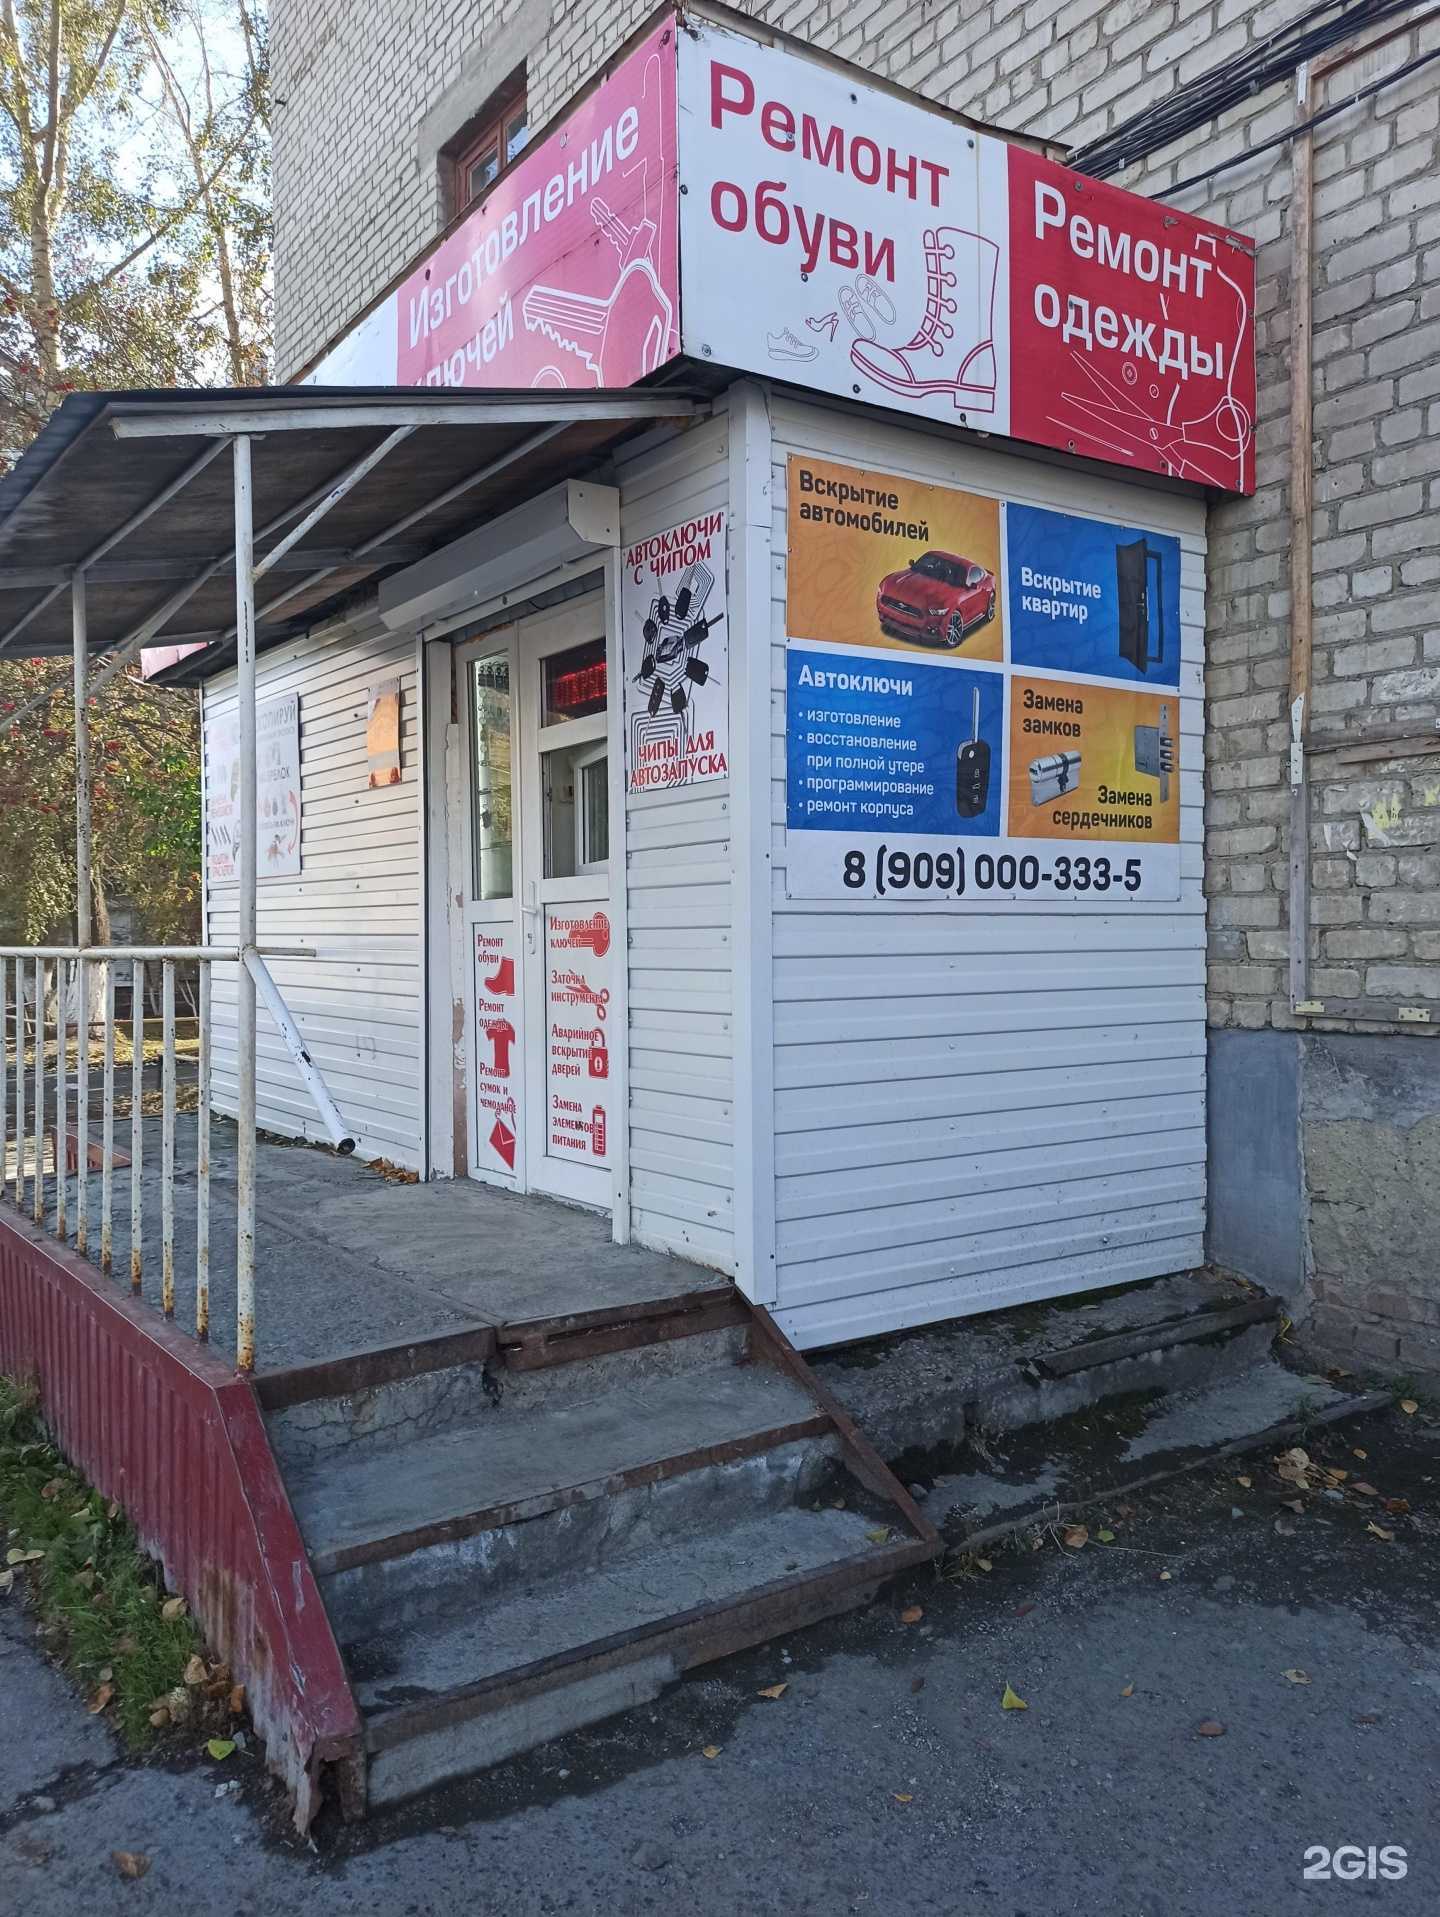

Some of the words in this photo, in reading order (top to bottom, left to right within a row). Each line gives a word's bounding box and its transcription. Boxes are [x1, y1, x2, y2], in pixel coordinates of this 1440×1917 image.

[709, 59, 950, 207] Ремонт
[409, 105, 639, 349] Изготовление
[710, 180, 896, 283] обуви
[1034, 179, 1213, 299] Ремонт
[1033, 283, 1224, 380] одежды
[799, 469, 899, 510] Вскрытие
[799, 502, 929, 542] автомобилей
[626, 513, 723, 569] АВТОКЛЮЧИ
[633, 565, 644, 585] С
[650, 538, 711, 579] ЧИПОМ
[1021, 566, 1102, 600] Вскрытие
[1021, 596, 1089, 624] квартир
[798, 664, 913, 697] Автоключи
[1023, 688, 1083, 714] Замена
[807, 710, 901, 729] изготовление
[1023, 718, 1081, 738] замков
[638, 738, 679, 763] ЧИПЫ
[685, 730, 715, 755] ДЛЯ
[807, 732, 917, 751] восстановление
[630, 752, 728, 788] АВТОЗАПУСКА
[807, 755, 832, 771] при
[835, 756, 885, 771] полной
[888, 762, 925, 777] утере
[807, 777, 934, 796] программирование
[1098, 784, 1153, 807] Замена
[807, 800, 858, 815] ремонт
[860, 803, 914, 819] корпуса
[1052, 810, 1153, 831] сердечников
[843, 849, 866, 890] 8
[876, 844, 966, 896] (909)
[974, 854, 1142, 892] 000-333-5
[477, 934, 504, 948] Ремонт
[478, 950, 499, 965] обуви
[479, 998, 505, 1012] Ремонт
[551, 1023, 599, 1043] Аварийное
[551, 1063, 580, 1078] дверей
[480, 1082, 501, 1095] сумок
[552, 1094, 582, 1113] Замена
[552, 1134, 586, 1151] питания
